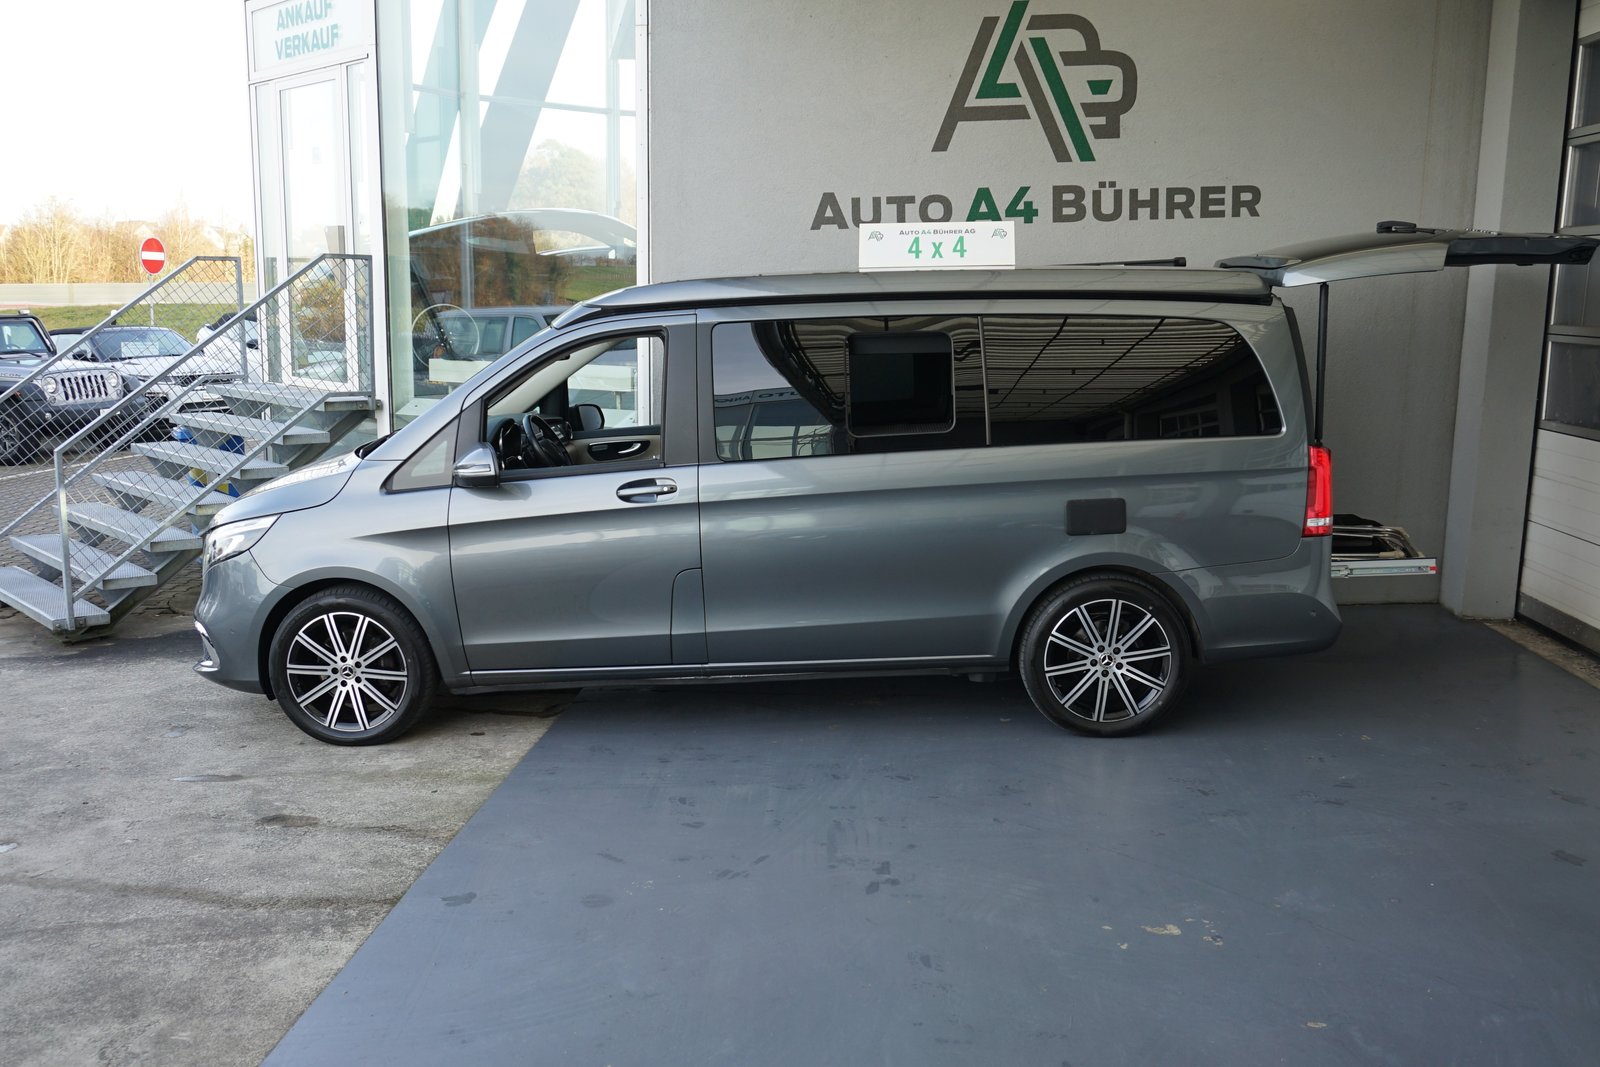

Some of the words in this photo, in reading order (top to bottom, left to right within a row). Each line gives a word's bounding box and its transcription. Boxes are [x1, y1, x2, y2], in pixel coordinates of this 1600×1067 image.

[277, 0, 333, 31] ANKAUF
[275, 23, 339, 60] VERKAUF
[810, 192, 953, 230] AUTO
[966, 185, 1039, 224] A4
[1052, 181, 1262, 223] BÜHRER
[907, 236, 922, 259] 4
[952, 235, 967, 258] 4
